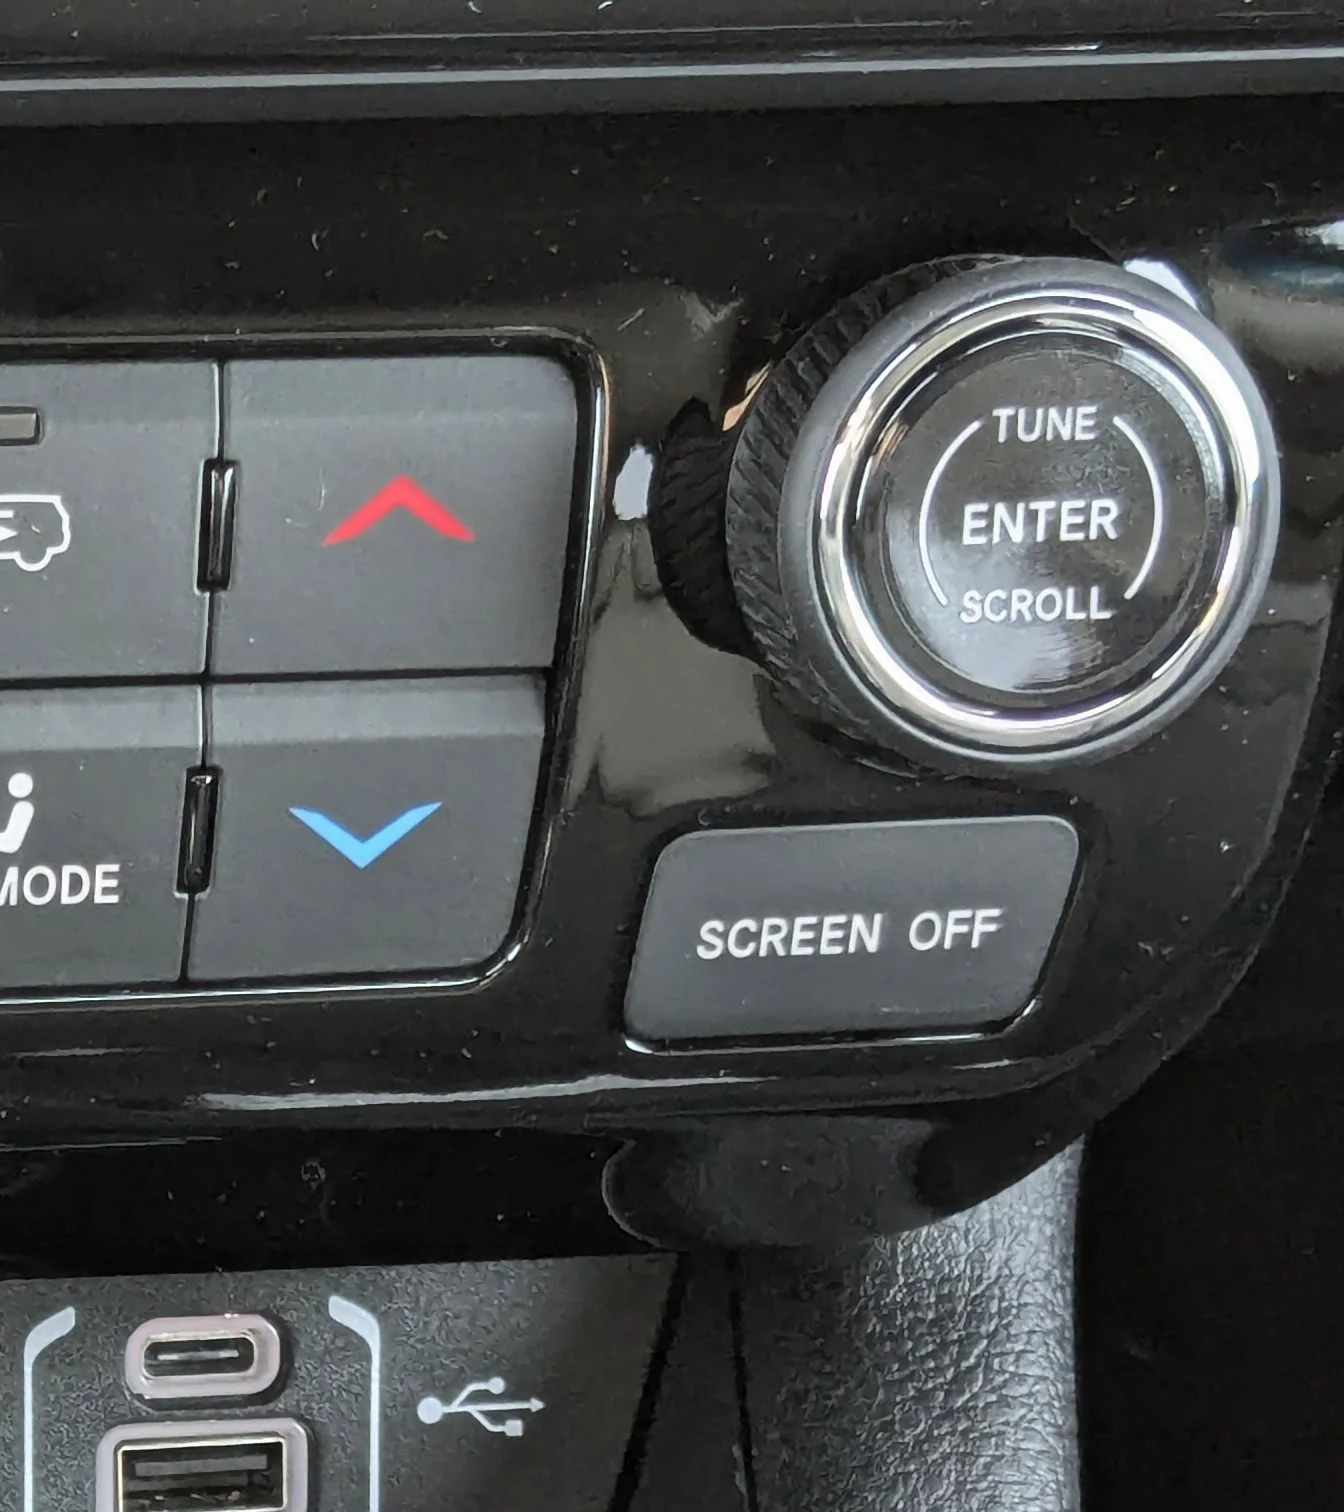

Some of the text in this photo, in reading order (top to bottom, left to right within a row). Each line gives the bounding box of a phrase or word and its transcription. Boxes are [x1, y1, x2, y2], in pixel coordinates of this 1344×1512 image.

[992, 405, 1097, 443] TUNE
[962, 498, 1119, 546] ENTER
[959, 586, 1111, 623] SCROLL
[696, 908, 1002, 960] SCREEN OFF
